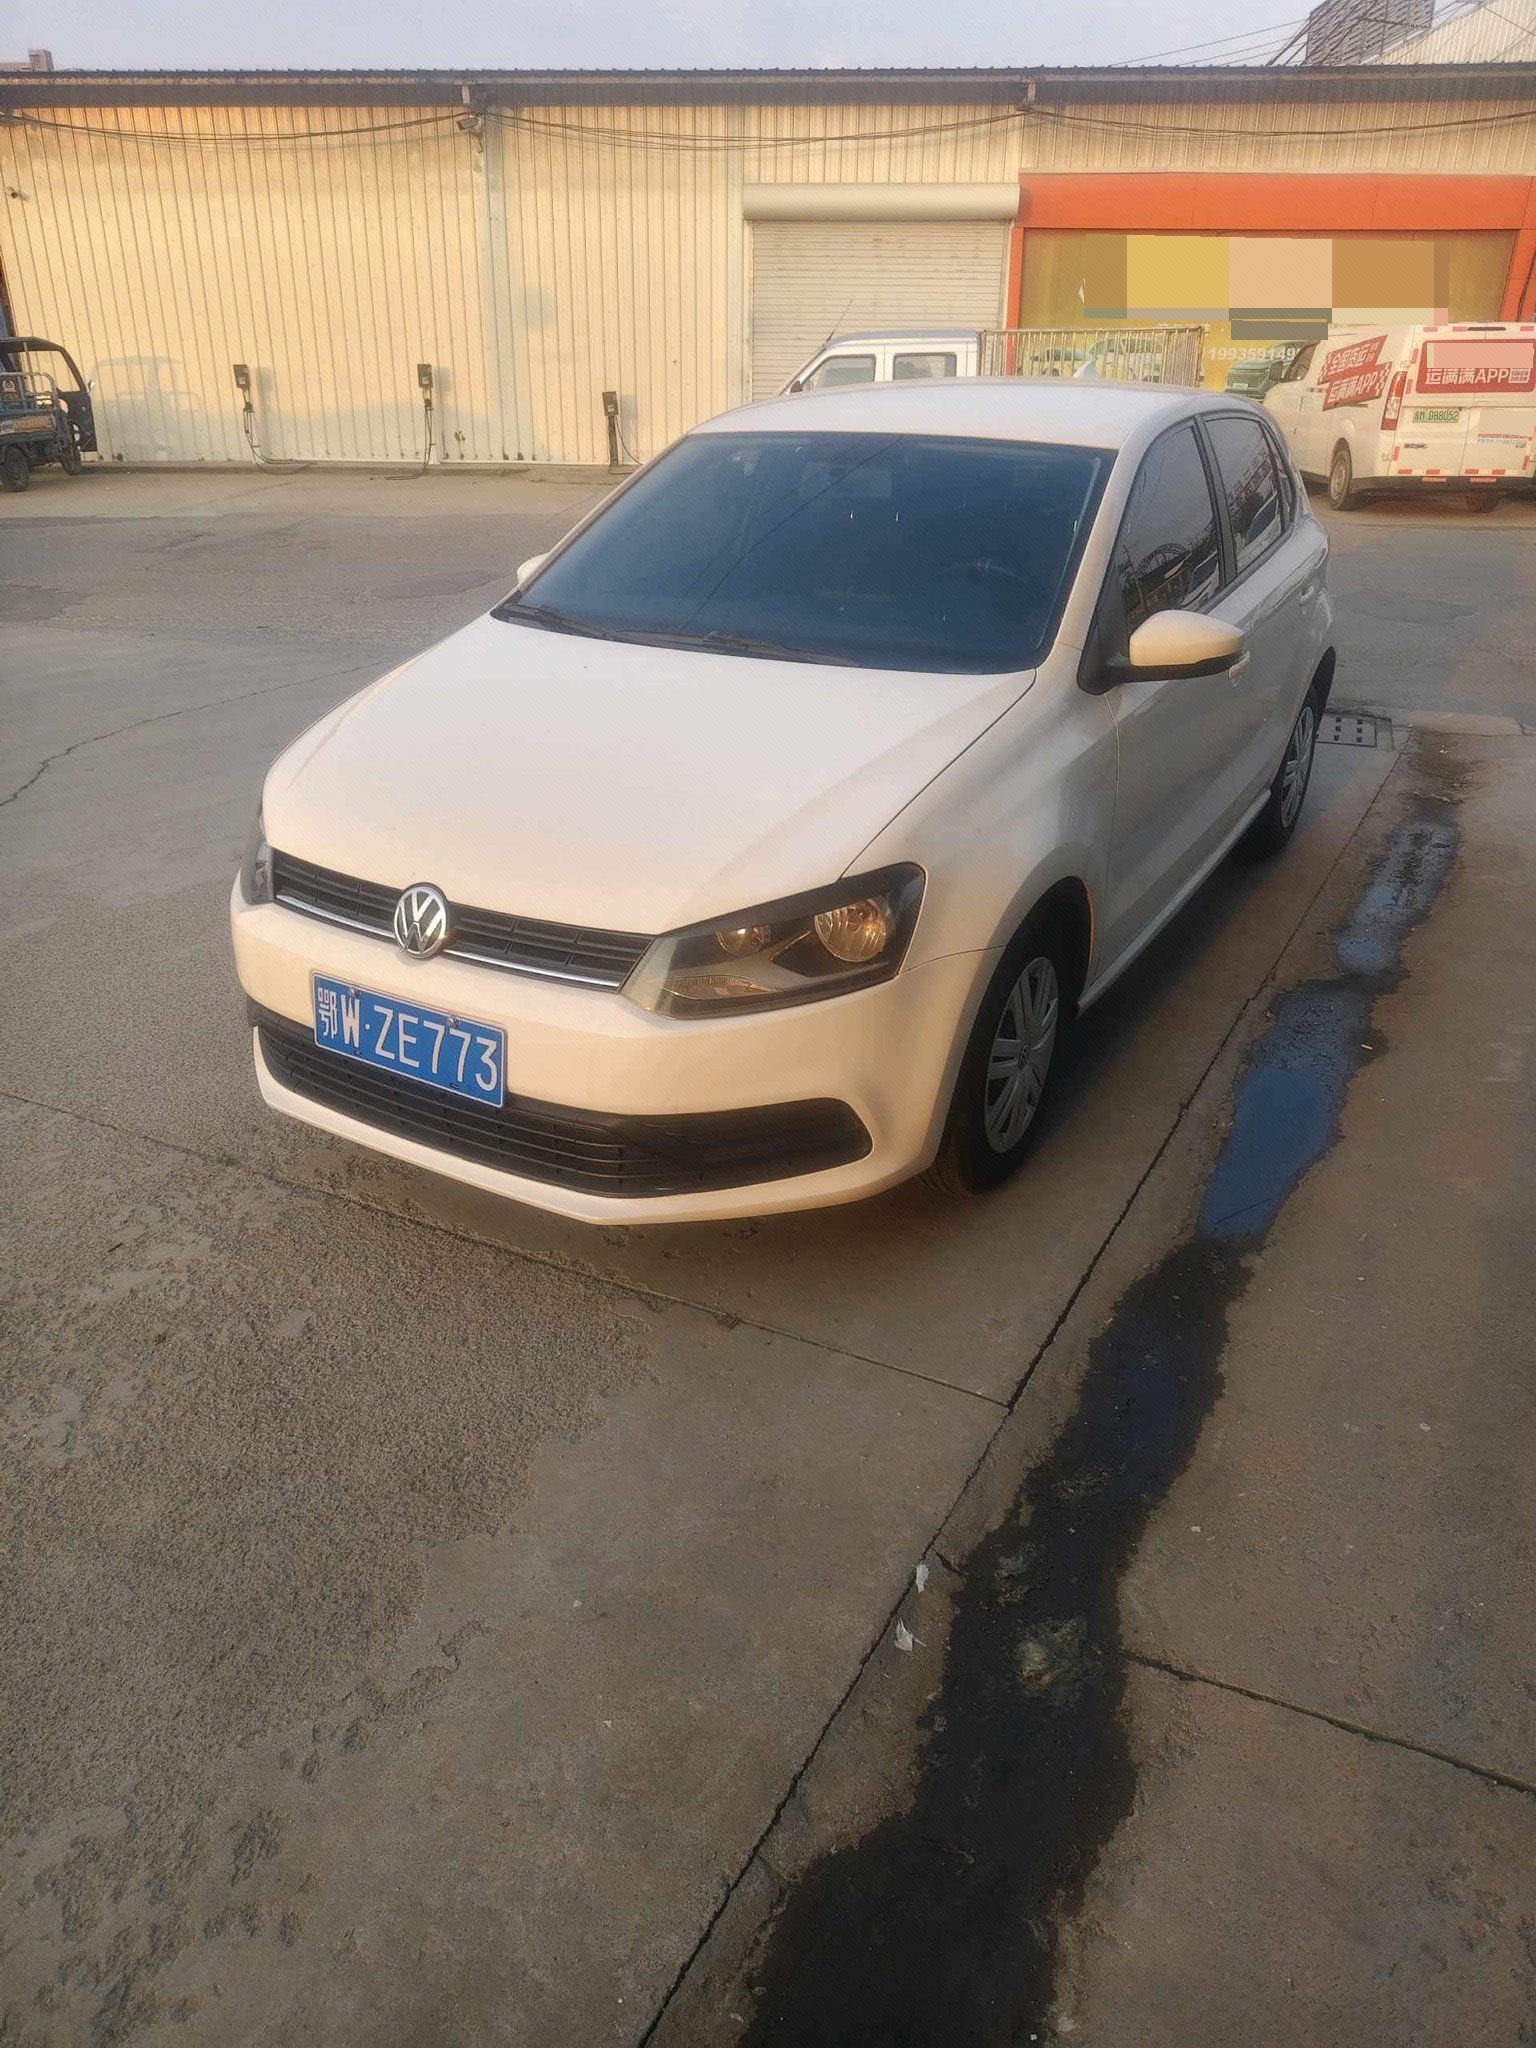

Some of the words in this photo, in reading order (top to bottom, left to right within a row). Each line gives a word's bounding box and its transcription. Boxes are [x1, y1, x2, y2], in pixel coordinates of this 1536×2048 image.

[1328, 371, 1378, 403] 运满满APP
[1425, 368, 1509, 385] 运满满APP
